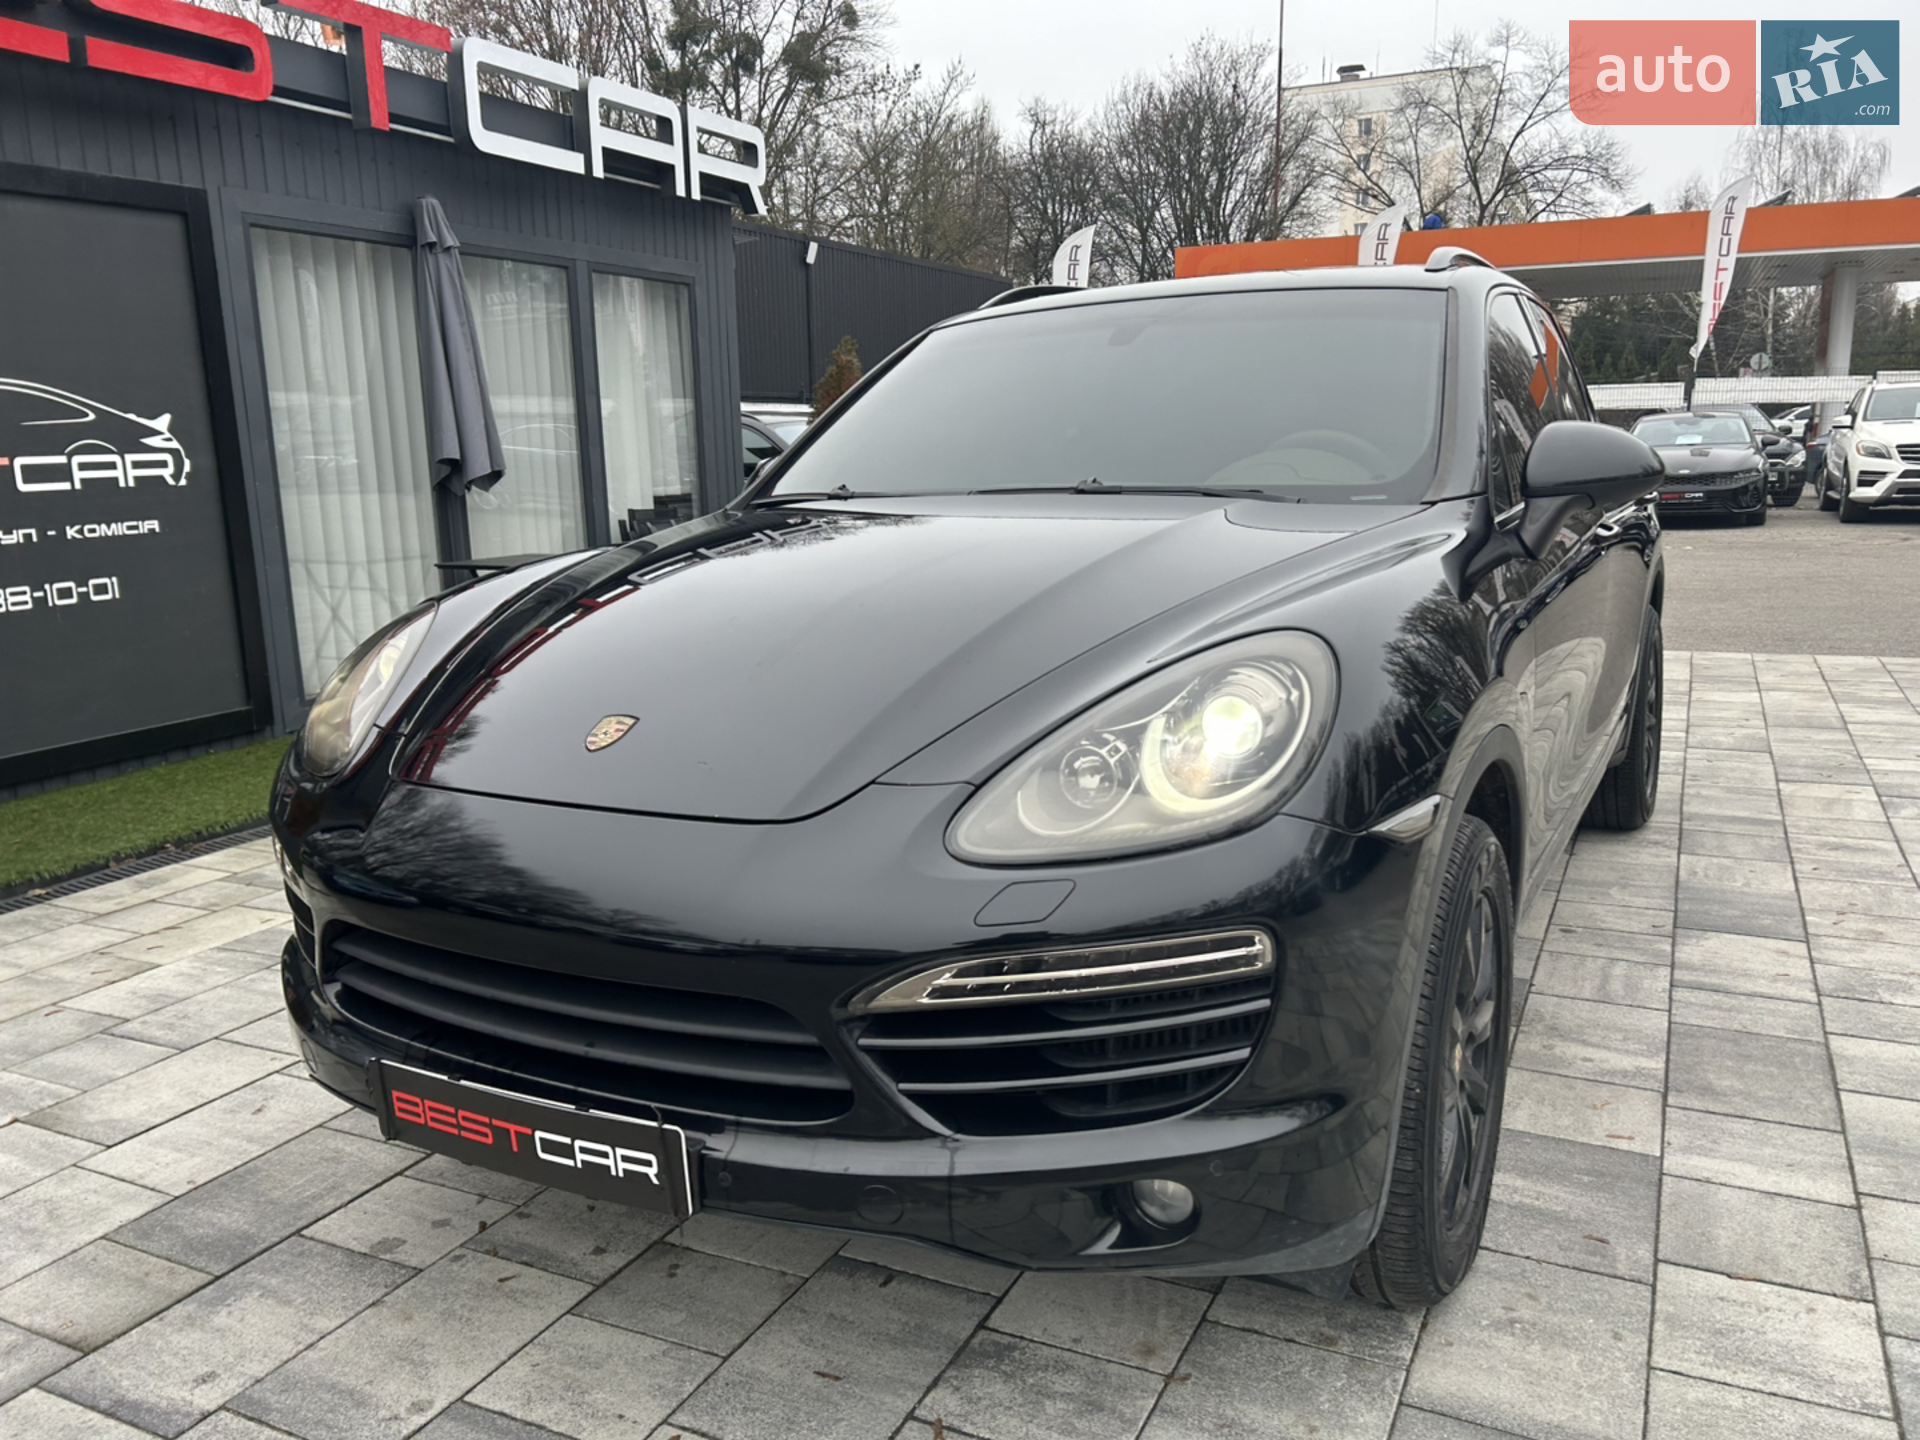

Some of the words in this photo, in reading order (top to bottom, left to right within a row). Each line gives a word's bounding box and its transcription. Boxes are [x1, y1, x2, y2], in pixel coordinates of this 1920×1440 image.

[0, 0, 768, 215] STCAR
[1067, 244, 1082, 286] AR
[1374, 222, 1392, 266] AR
[0, 453, 176, 492] CAR
[0, 576, 121, 613] 8-10-01
[391, 1089, 660, 1185] BESTCAR
